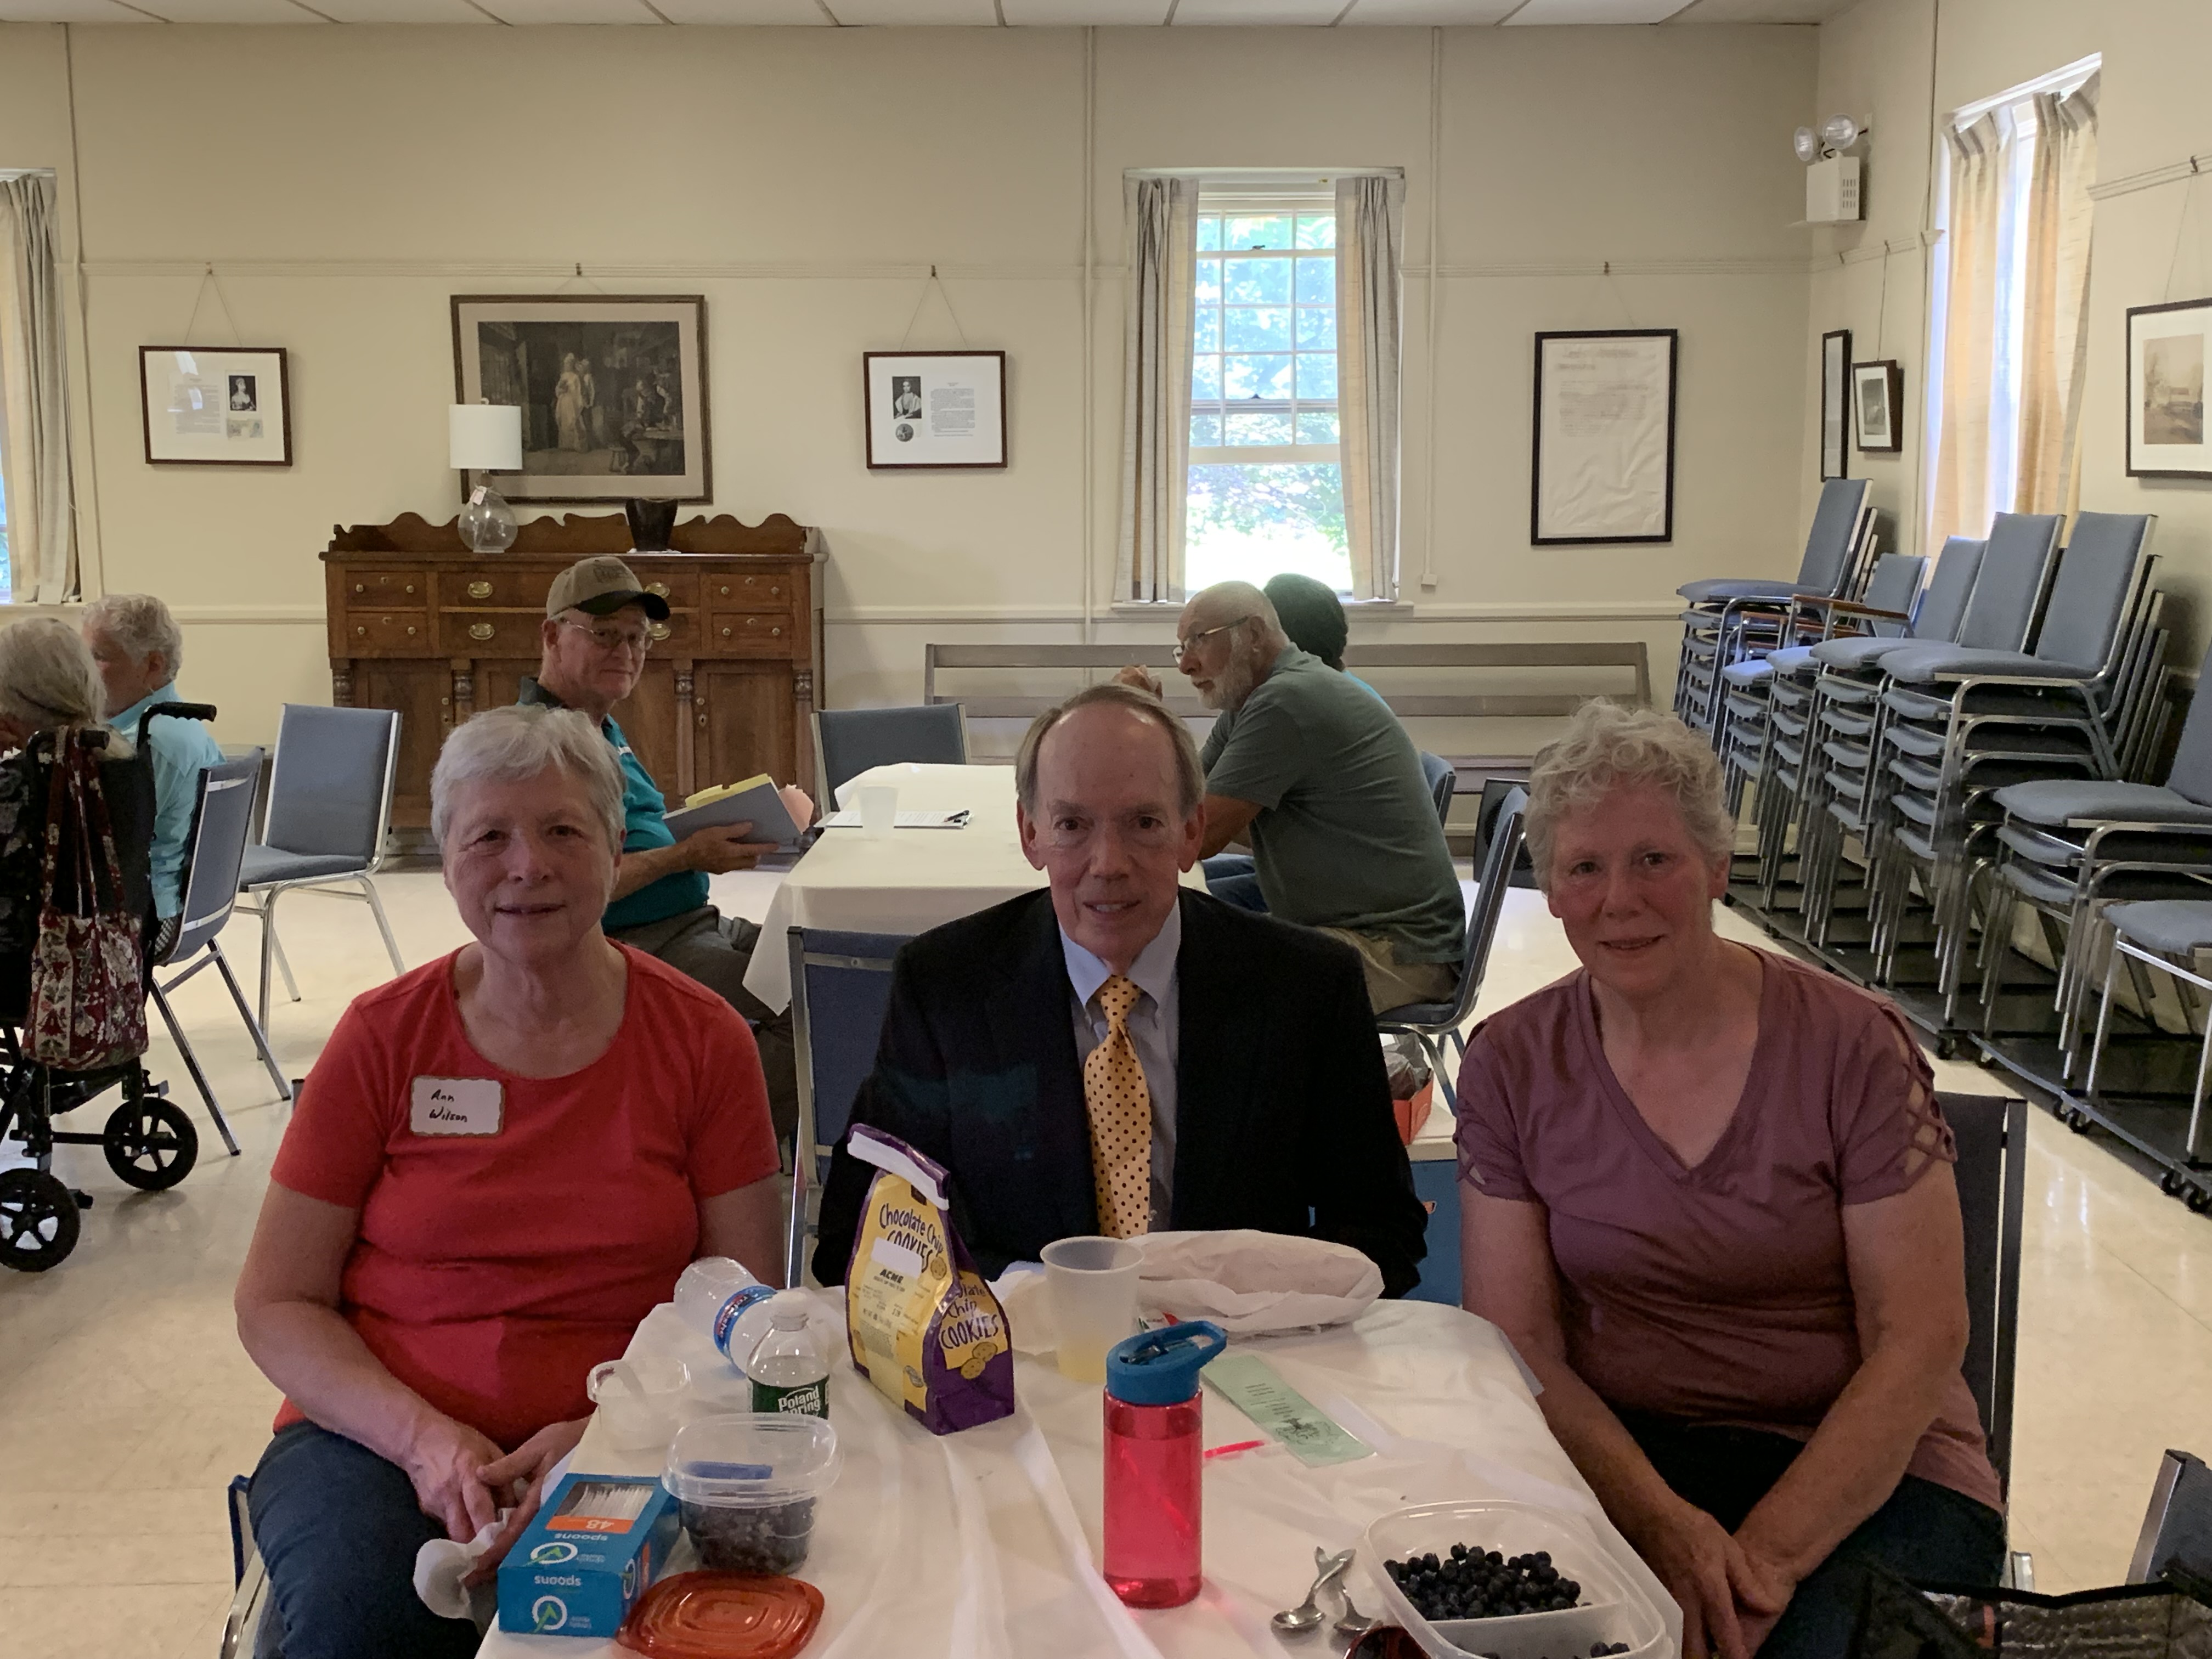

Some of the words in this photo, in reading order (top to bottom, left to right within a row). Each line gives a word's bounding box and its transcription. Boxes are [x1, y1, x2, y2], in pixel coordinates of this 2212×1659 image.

[431, 1089, 454, 1102] Ann
[429, 1107, 467, 1122] Wilson
[879, 1203, 926, 1236] Chocolate
[927, 1223, 944, 1257] Chip
[879, 1268, 904, 1284] ACME
[947, 1298, 977, 1318] Chip
[941, 1313, 999, 1350] COOKIES
[777, 1385, 820, 1413] Poland
[789, 1398, 821, 1415] pring
[585, 1519, 615, 1530] 48
[554, 1533, 610, 1542] spoons
[534, 1575, 582, 1587] spoons
